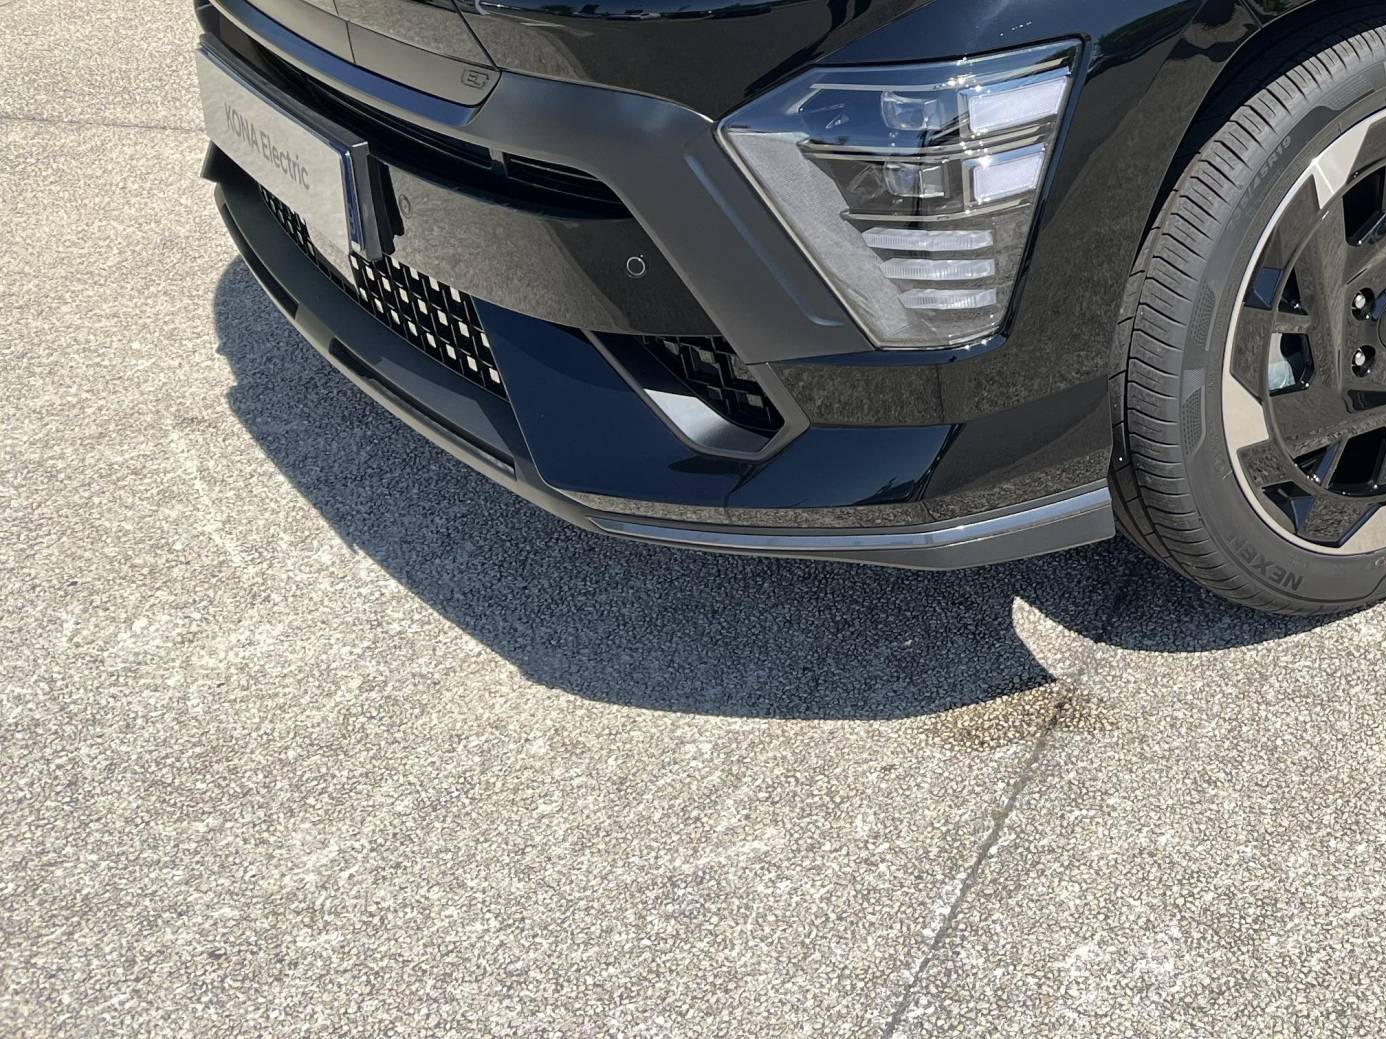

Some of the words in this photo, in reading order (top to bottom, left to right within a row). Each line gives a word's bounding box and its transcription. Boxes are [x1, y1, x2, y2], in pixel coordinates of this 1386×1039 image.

[224, 102, 260, 153] KONA
[259, 130, 310, 191] Electric
[1225, 535, 1304, 591] NEXEN
